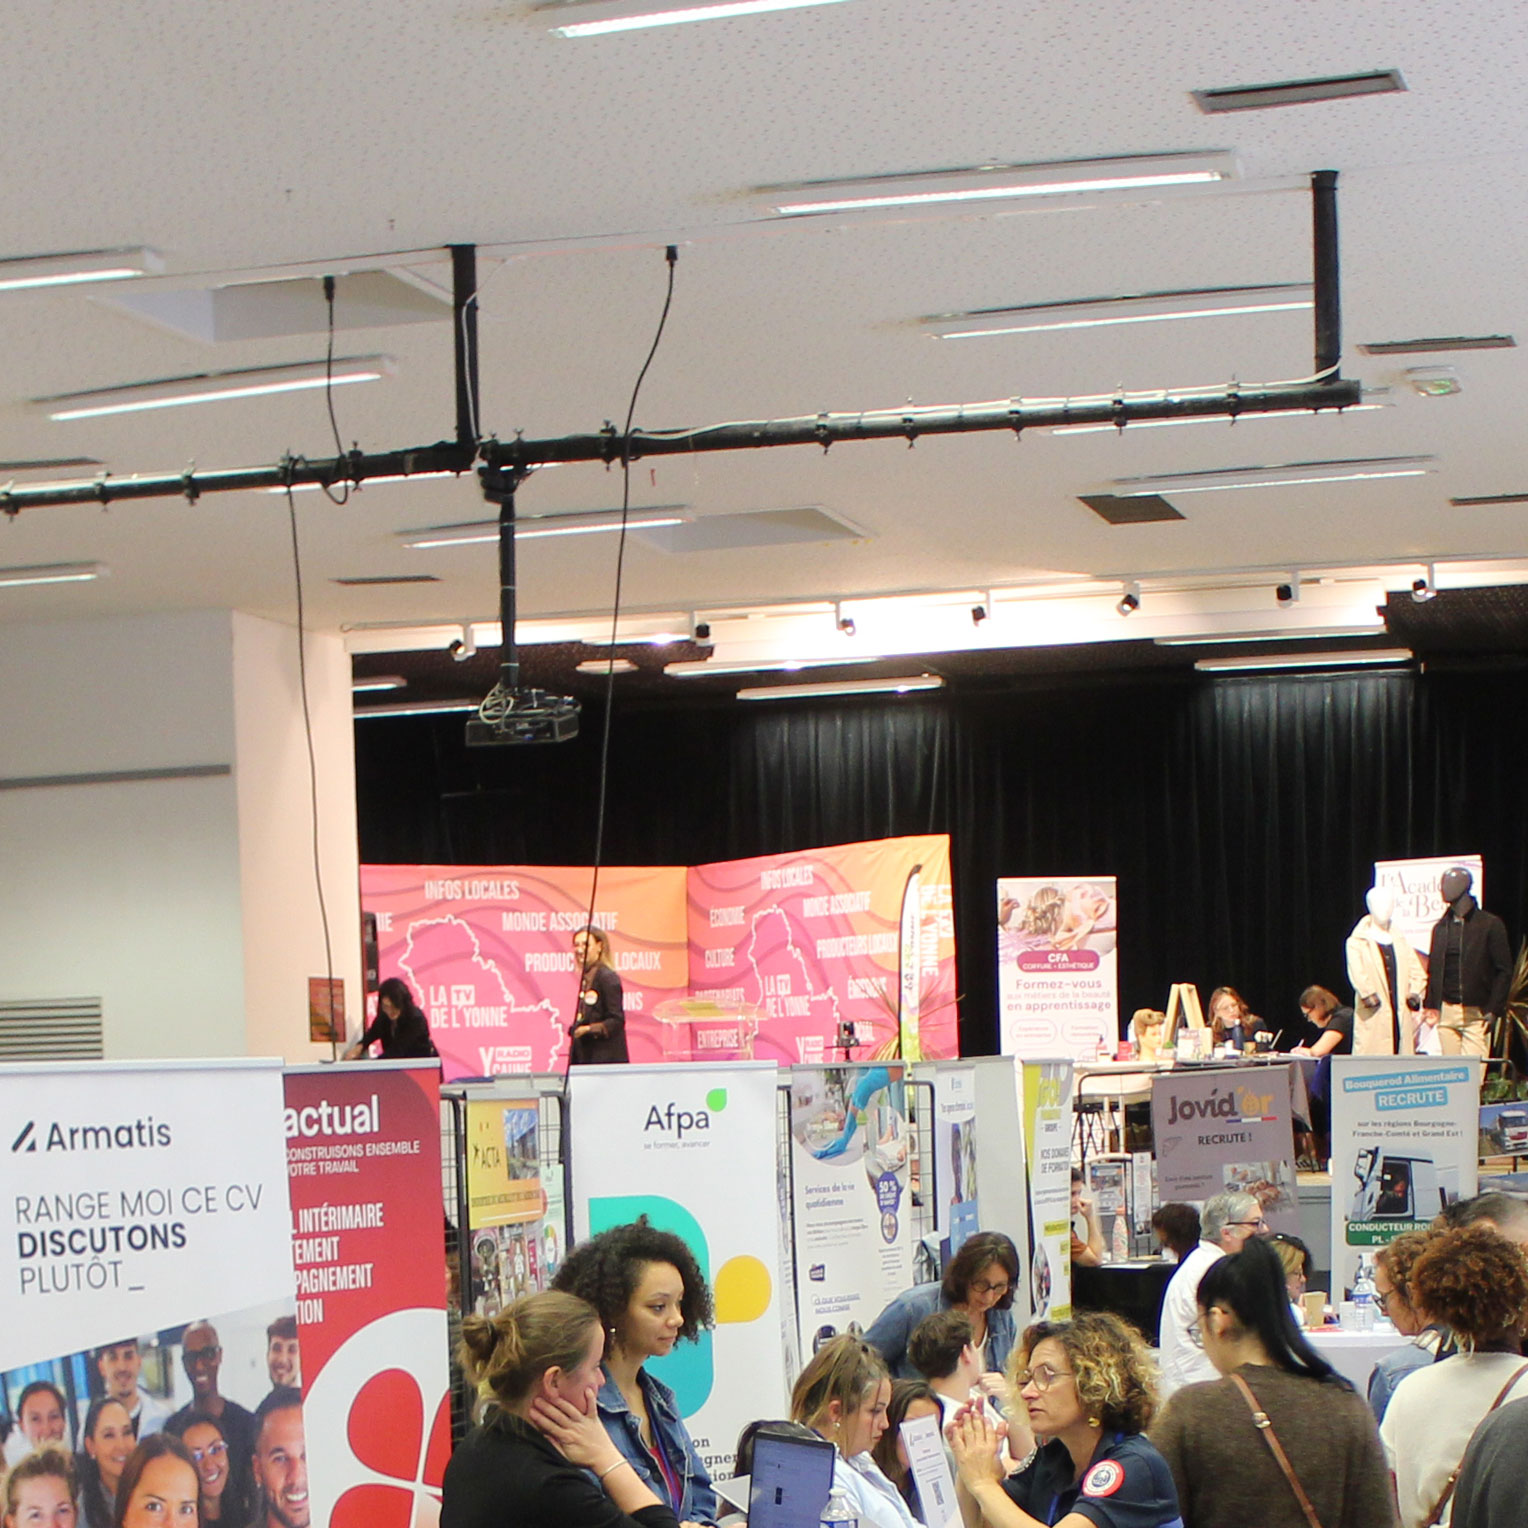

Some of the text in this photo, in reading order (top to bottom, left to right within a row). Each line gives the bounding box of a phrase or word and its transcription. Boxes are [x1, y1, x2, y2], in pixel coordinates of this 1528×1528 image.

[760, 866, 814, 890] INFOS LOCALES
[425, 880, 520, 899] INFOS LOCALES
[502, 912, 547, 931] MONDE
[614, 951, 662, 971] LOCAUX
[705, 948, 735, 969] CULTURE
[1047, 953, 1069, 963] CFA
[765, 976, 776, 995] LA
[1016, 979, 1102, 990] Formez-vous
[429, 985, 474, 1005] LA TV
[1007, 999, 1111, 1012] en apprentissage
[431, 1008, 449, 1028] DE
[697, 1029, 739, 1049] ENTREPRISE
[496, 1048, 532, 1061] RADIO
[1404, 1070, 1466, 1086] Alimentaire
[1378, 1089, 1445, 1108] RECRUTE
[284, 1095, 380, 1138] actual
[643, 1101, 711, 1140] Afpa
[45, 1115, 172, 1152] Armatis
[1197, 1132, 1246, 1146] RECRUTE
[1422, 1129, 1445, 1137] Grand
[365, 1139, 421, 1157] ENSEMBLE
[681, 1140, 711, 1149] avancer
[318, 1155, 360, 1175] TRAVAIL
[14, 1183, 264, 1225] RANGE MOI CE CV
[299, 1201, 385, 1233] INTÉRIMAIRE
[1348, 1222, 1413, 1232] CONDUCTEUR
[17, 1221, 188, 1259] DISCUTONS
[1371, 1235, 1384, 1243] PL
